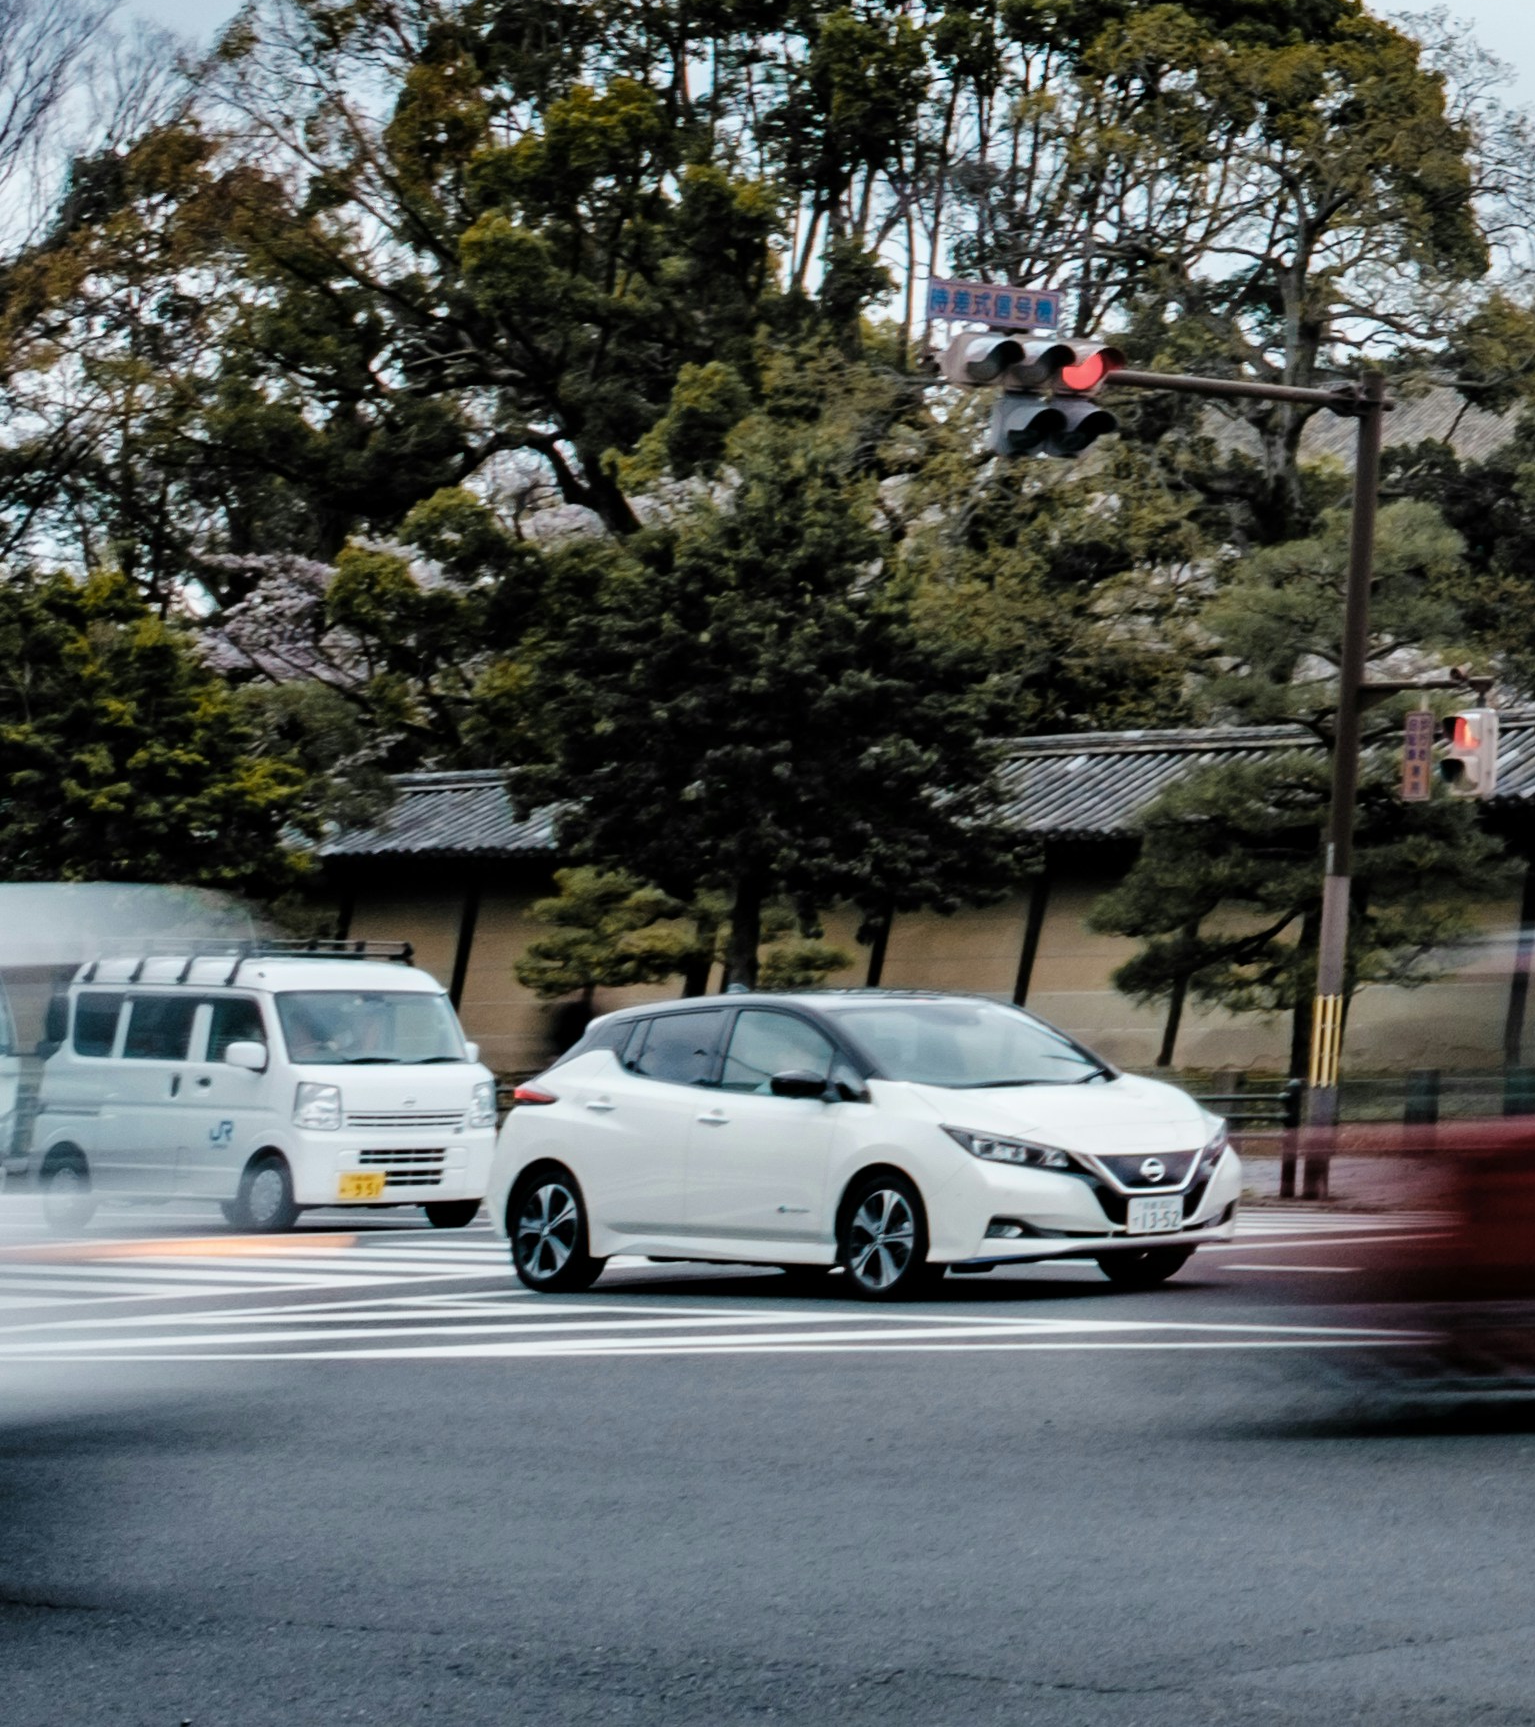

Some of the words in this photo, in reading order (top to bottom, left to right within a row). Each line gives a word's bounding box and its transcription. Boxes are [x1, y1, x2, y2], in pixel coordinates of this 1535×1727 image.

[930, 287, 1054, 323] 時差式信号機
[209, 1120, 234, 1142] JR
